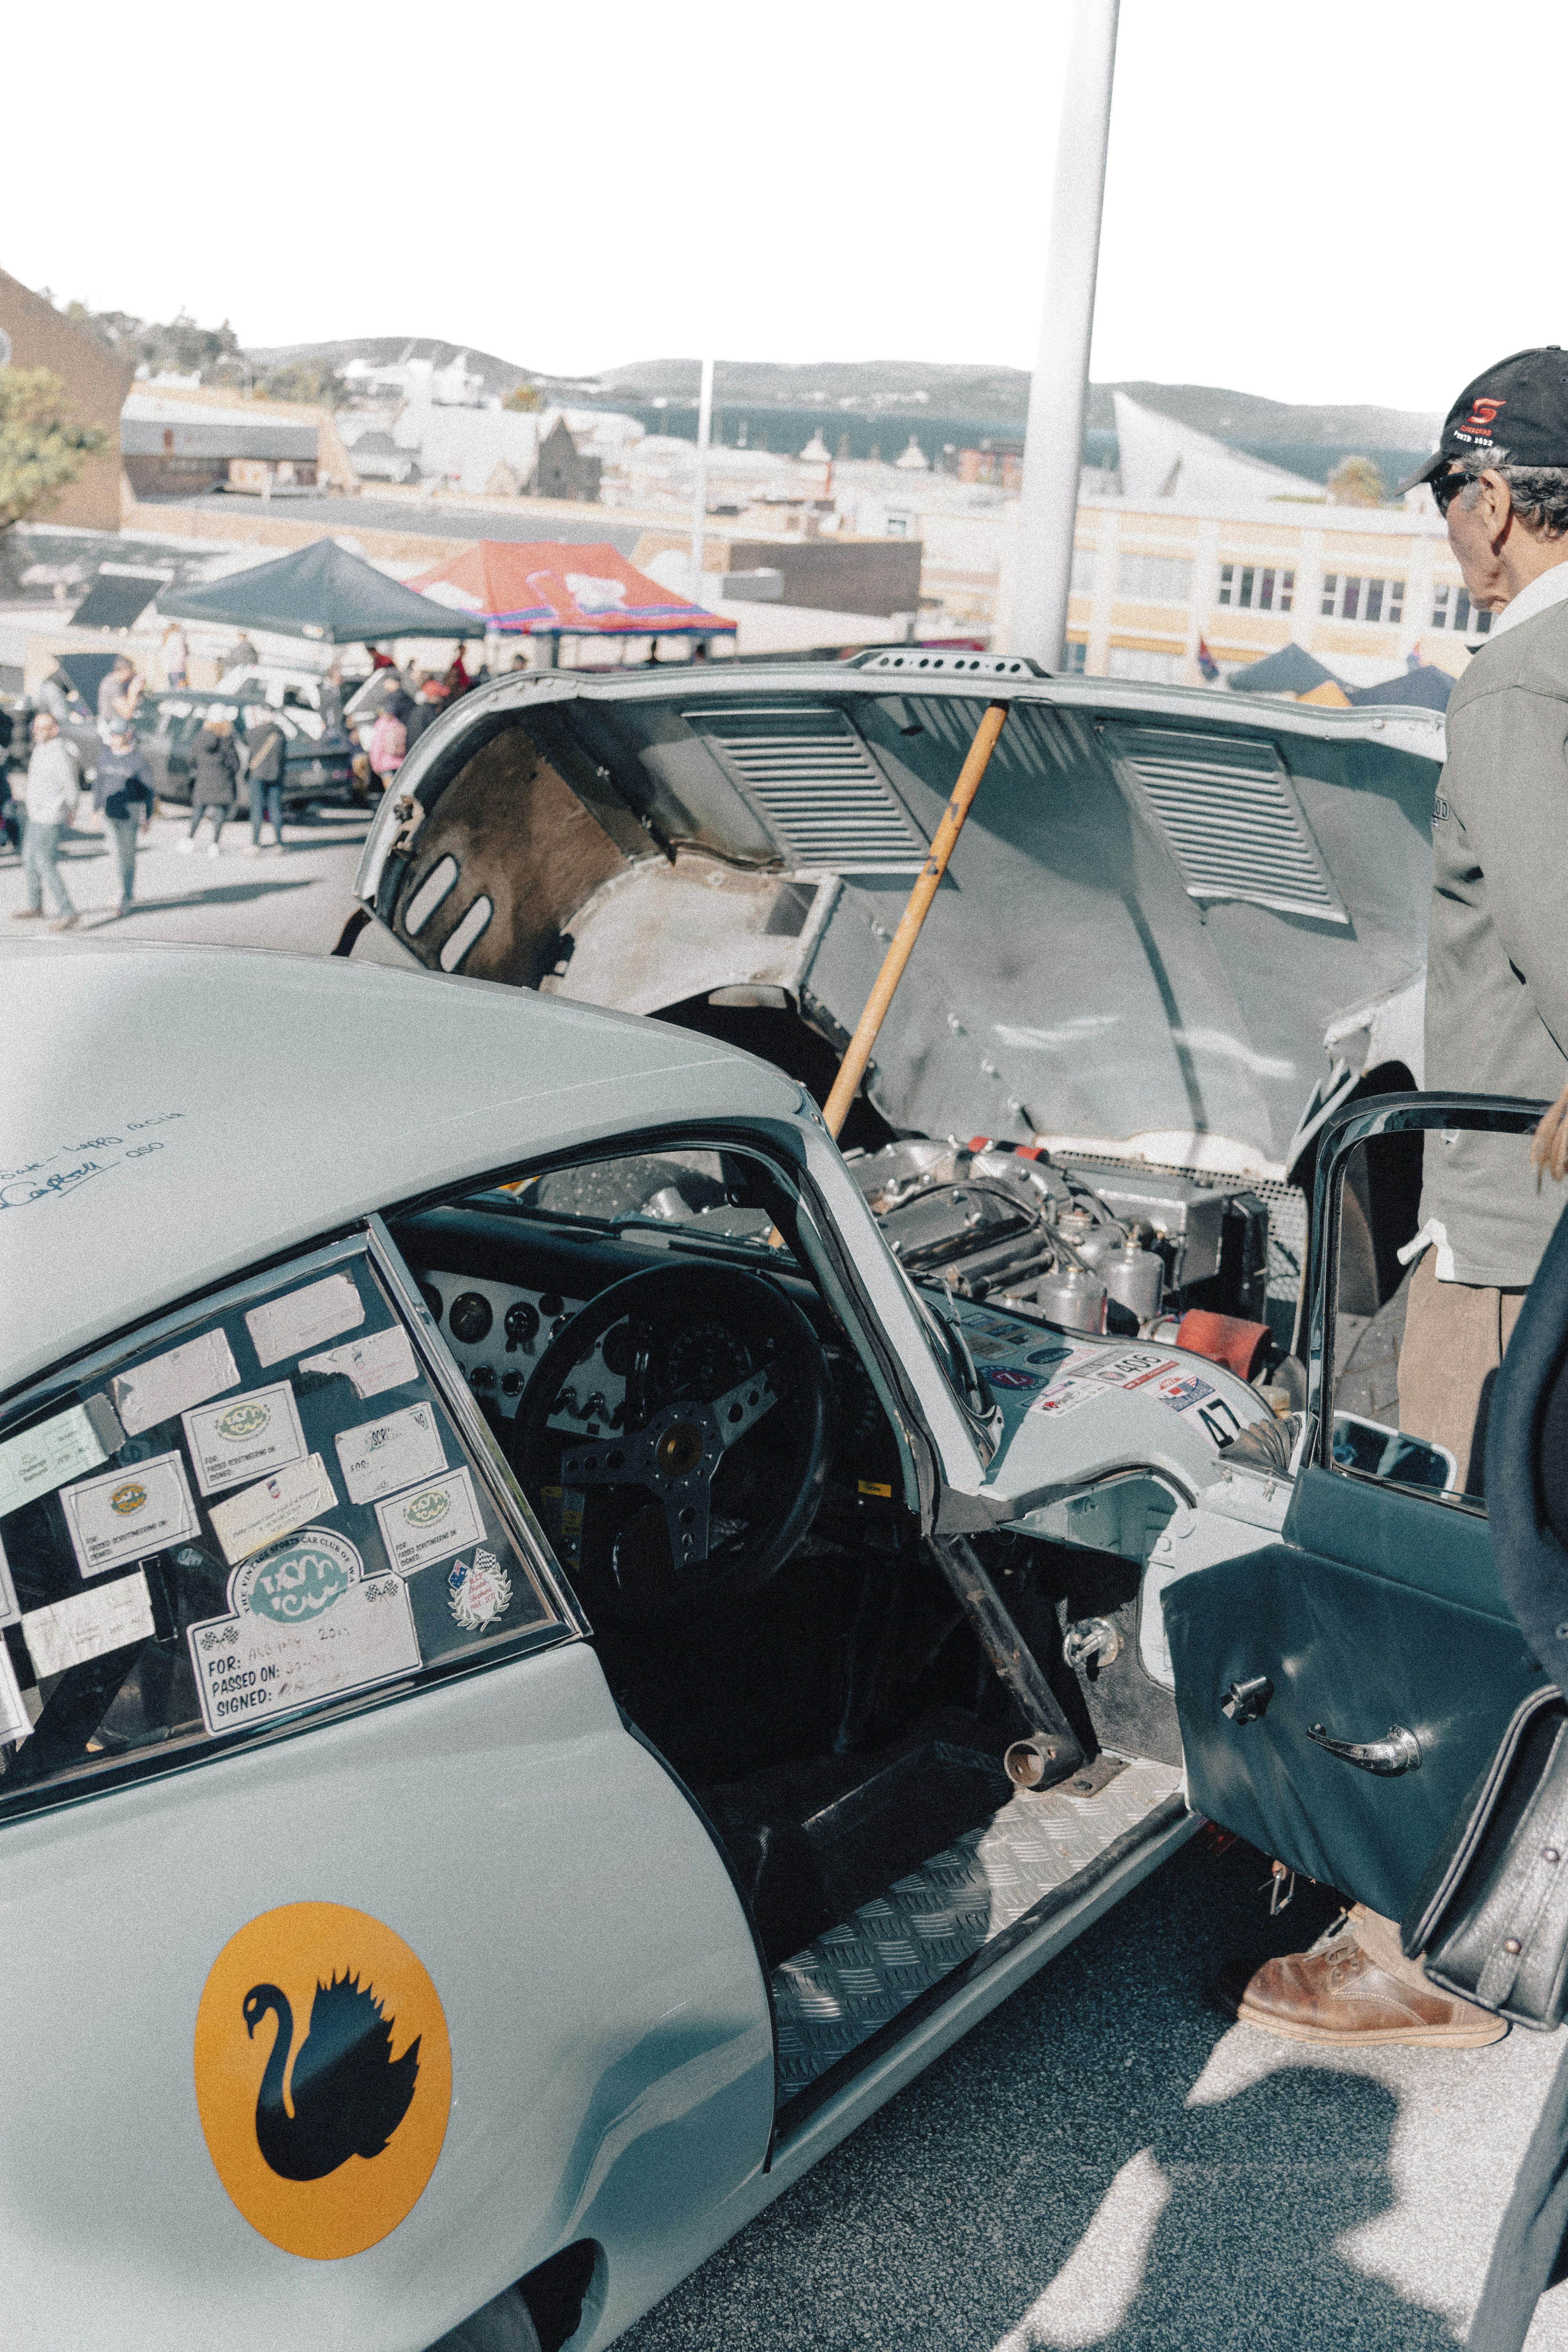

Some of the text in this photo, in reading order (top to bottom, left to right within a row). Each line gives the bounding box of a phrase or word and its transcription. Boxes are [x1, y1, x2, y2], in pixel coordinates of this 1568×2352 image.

[1474, 437, 1493, 446] 2022
[1114, 1354, 1161, 1372] 406
[270, 1537, 300, 1554] SPORTS
[319, 1538, 340, 1552] CLUB
[341, 1551, 350, 1563] OF
[242, 1551, 269, 1586] VINTAGE
[348, 1566, 356, 1583] WA
[241, 1594, 250, 1614] THE
[209, 1656, 241, 1677] FOR:
[212, 1671, 256, 1697] PASSED
[261, 1664, 280, 1682] ON:
[217, 1689, 272, 1717] SIGNED:
